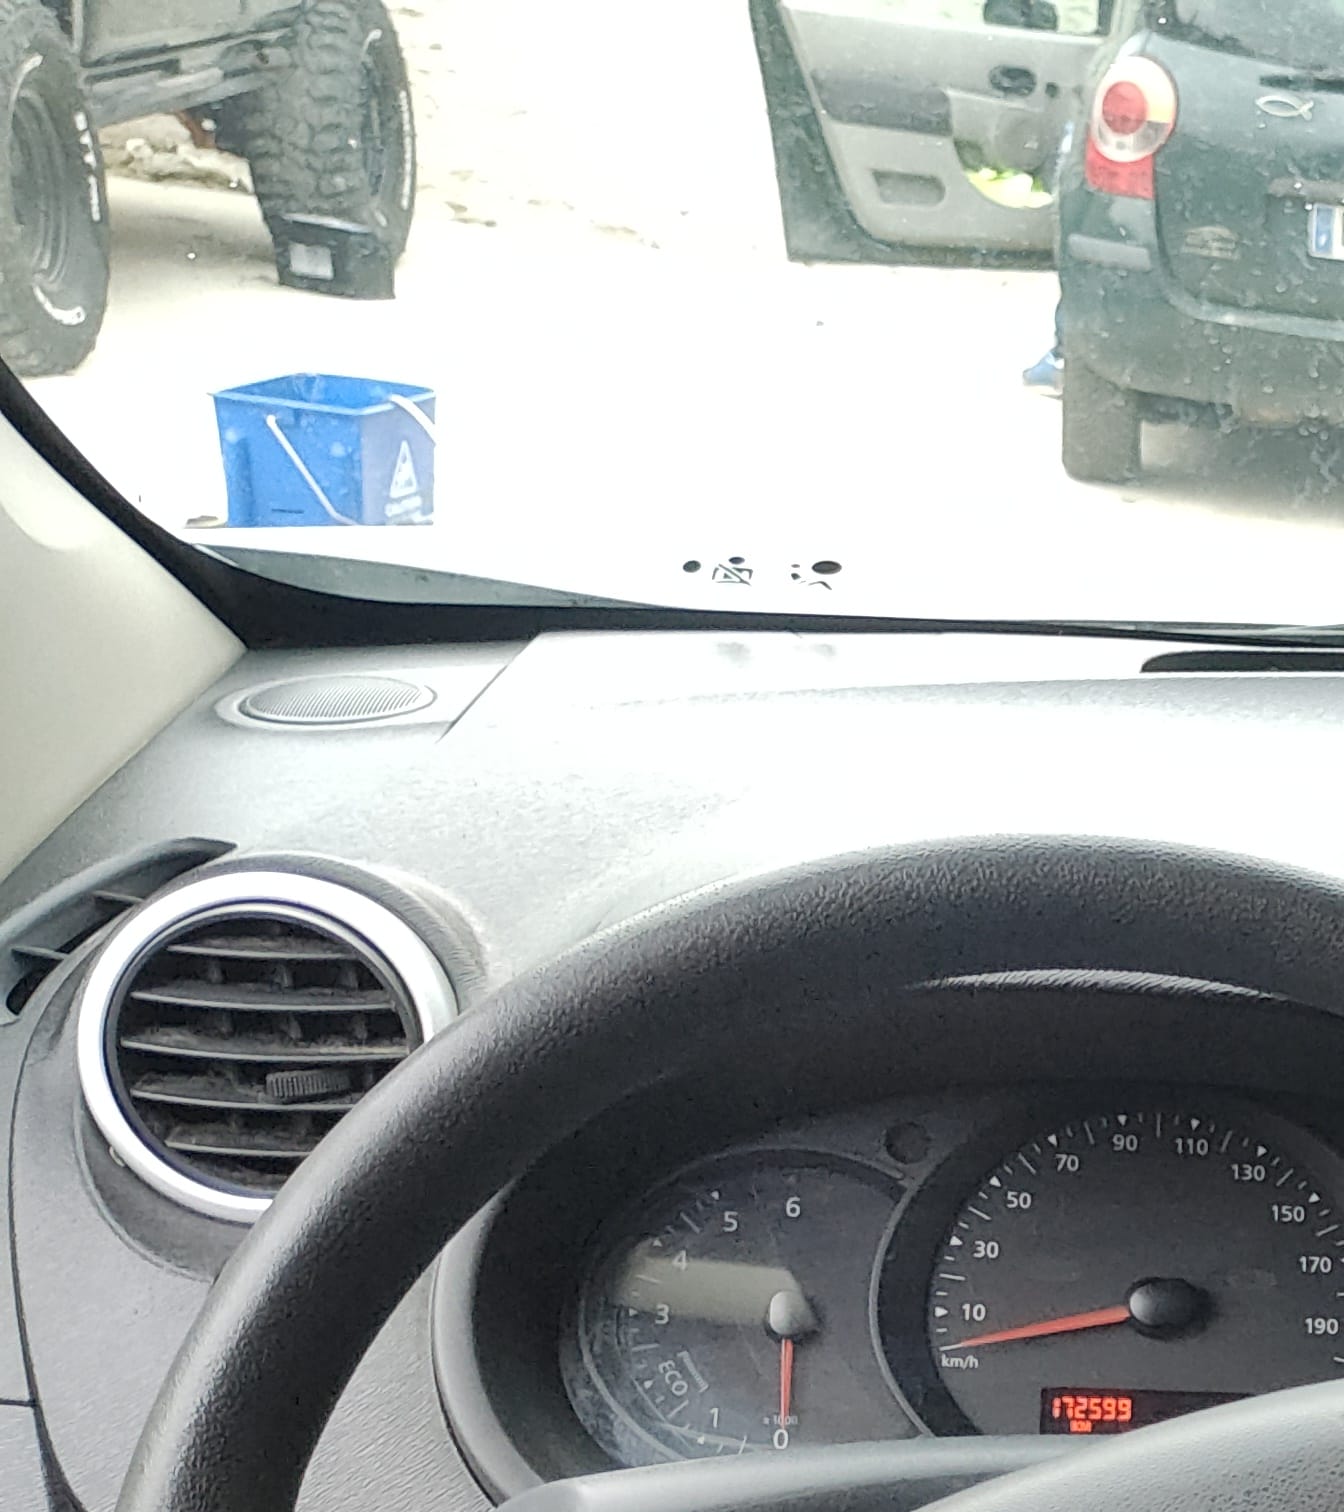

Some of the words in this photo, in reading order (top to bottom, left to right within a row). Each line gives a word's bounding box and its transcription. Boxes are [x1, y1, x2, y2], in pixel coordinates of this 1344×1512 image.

[1112, 1134, 1138, 1151] 90
[1175, 1137, 1209, 1156] 110
[1056, 1154, 1079, 1172] 70
[1231, 1164, 1266, 1181] 130
[785, 1196, 801, 1218] 6
[1007, 1191, 1032, 1209] 50
[723, 1211, 738, 1232] 5
[1272, 1205, 1305, 1222] 150
[973, 1240, 999, 1258] 30
[672, 1250, 688, 1270] 4
[1299, 1256, 1332, 1273] 170
[655, 1305, 670, 1324] 3
[962, 1303, 986, 1321] 10
[1305, 1317, 1339, 1335] 190
[941, 1354, 979, 1369] km/h
[658, 1359, 689, 1396] ECO
[710, 1407, 719, 1428] 1
[1052, 1396, 1132, 1421] 172599
[772, 1429, 789, 1450] 0
